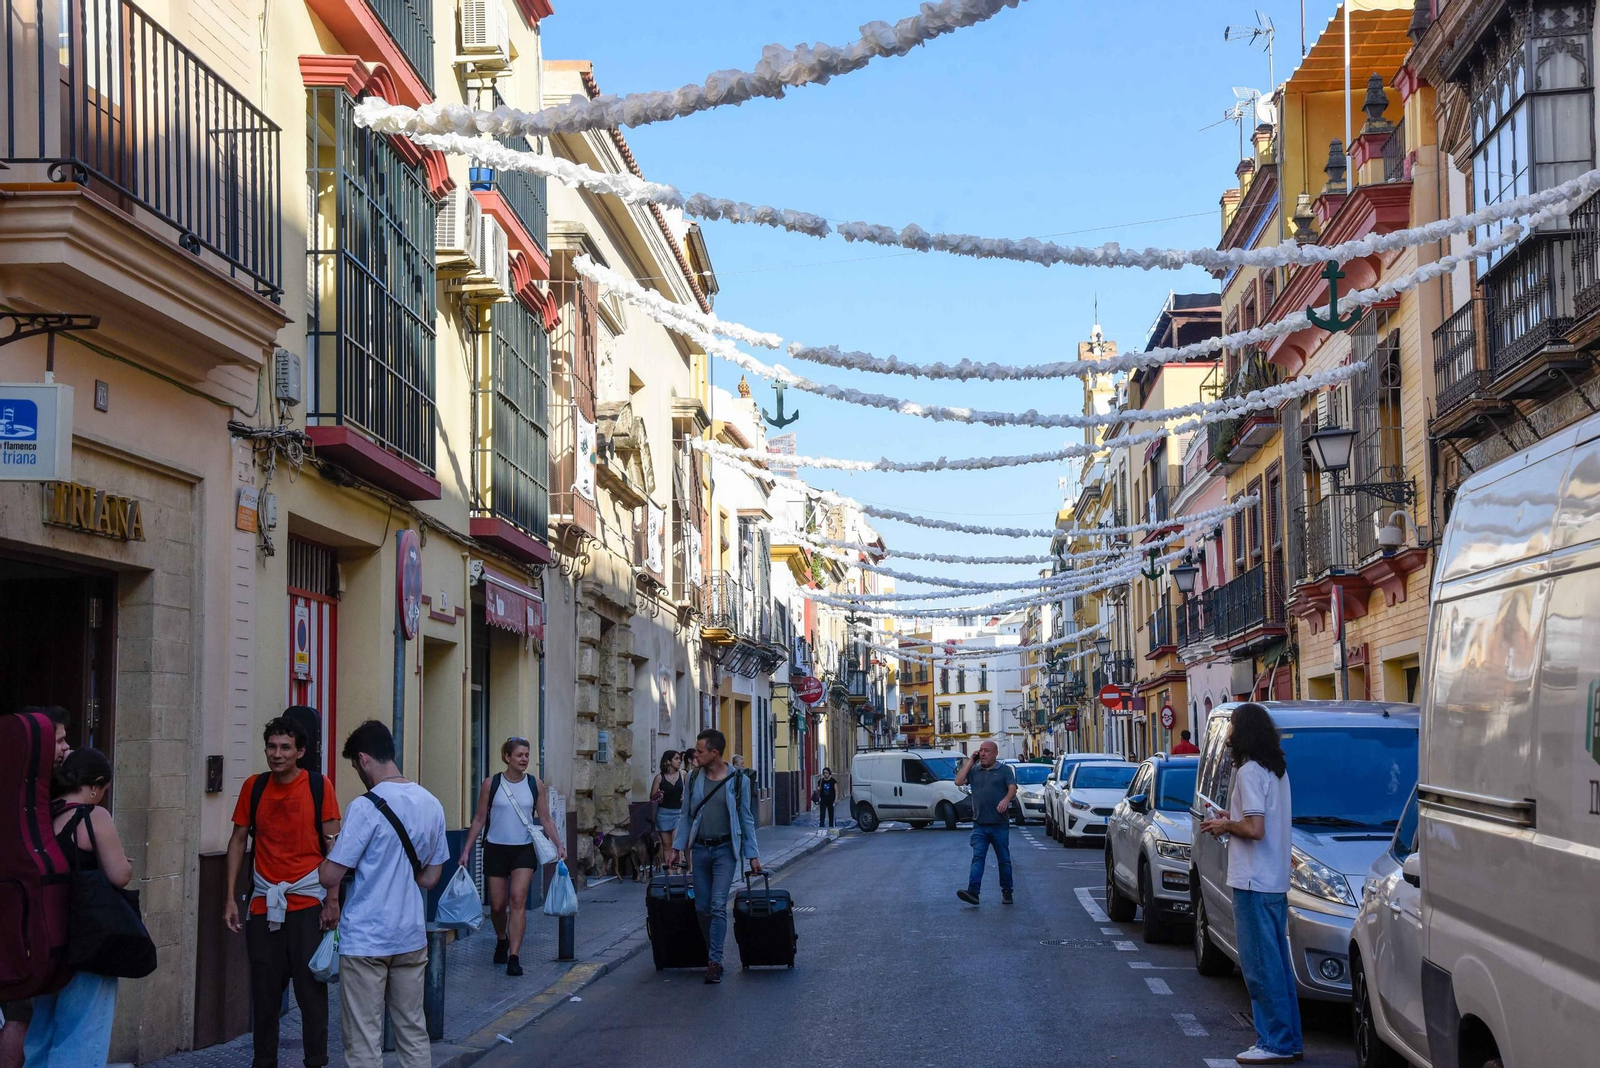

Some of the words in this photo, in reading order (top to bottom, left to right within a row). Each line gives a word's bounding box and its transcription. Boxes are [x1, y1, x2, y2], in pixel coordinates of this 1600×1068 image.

[4, 441, 37, 451] flamenco
[3, 451, 37, 465] triana
[47, 482, 146, 542] TRIANA
